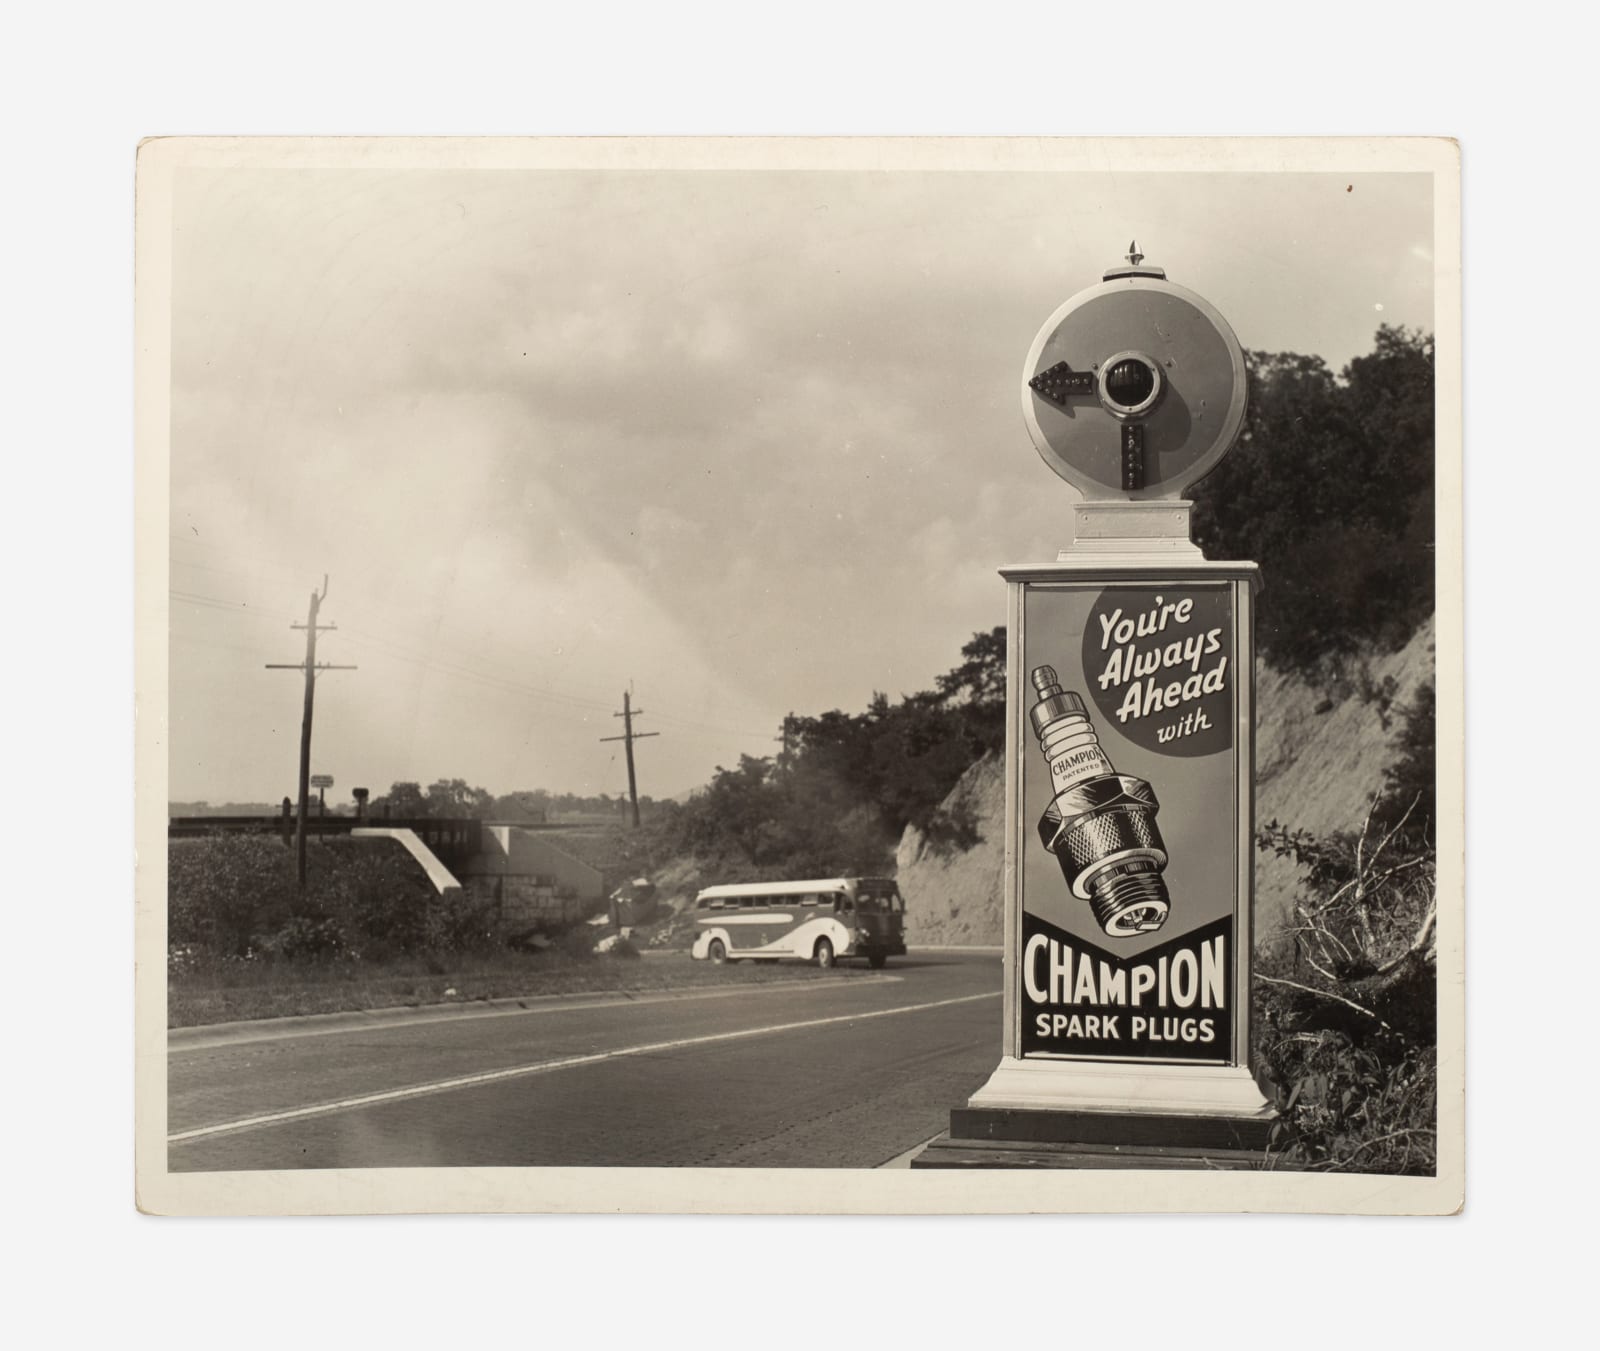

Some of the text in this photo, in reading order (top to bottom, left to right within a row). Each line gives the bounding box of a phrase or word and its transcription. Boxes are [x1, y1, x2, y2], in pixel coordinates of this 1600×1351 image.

[1099, 596, 1194, 650] You're
[1098, 628, 1222, 690] Always
[1116, 656, 1228, 723] Ahead
[1157, 707, 1212, 744] with
[1052, 747, 1102, 776] CHAMPION
[1062, 763, 1100, 781] PATENTED
[1024, 933, 1225, 1009] CHAMPION
[1036, 1013, 1215, 1042] SPARK PLUGS
